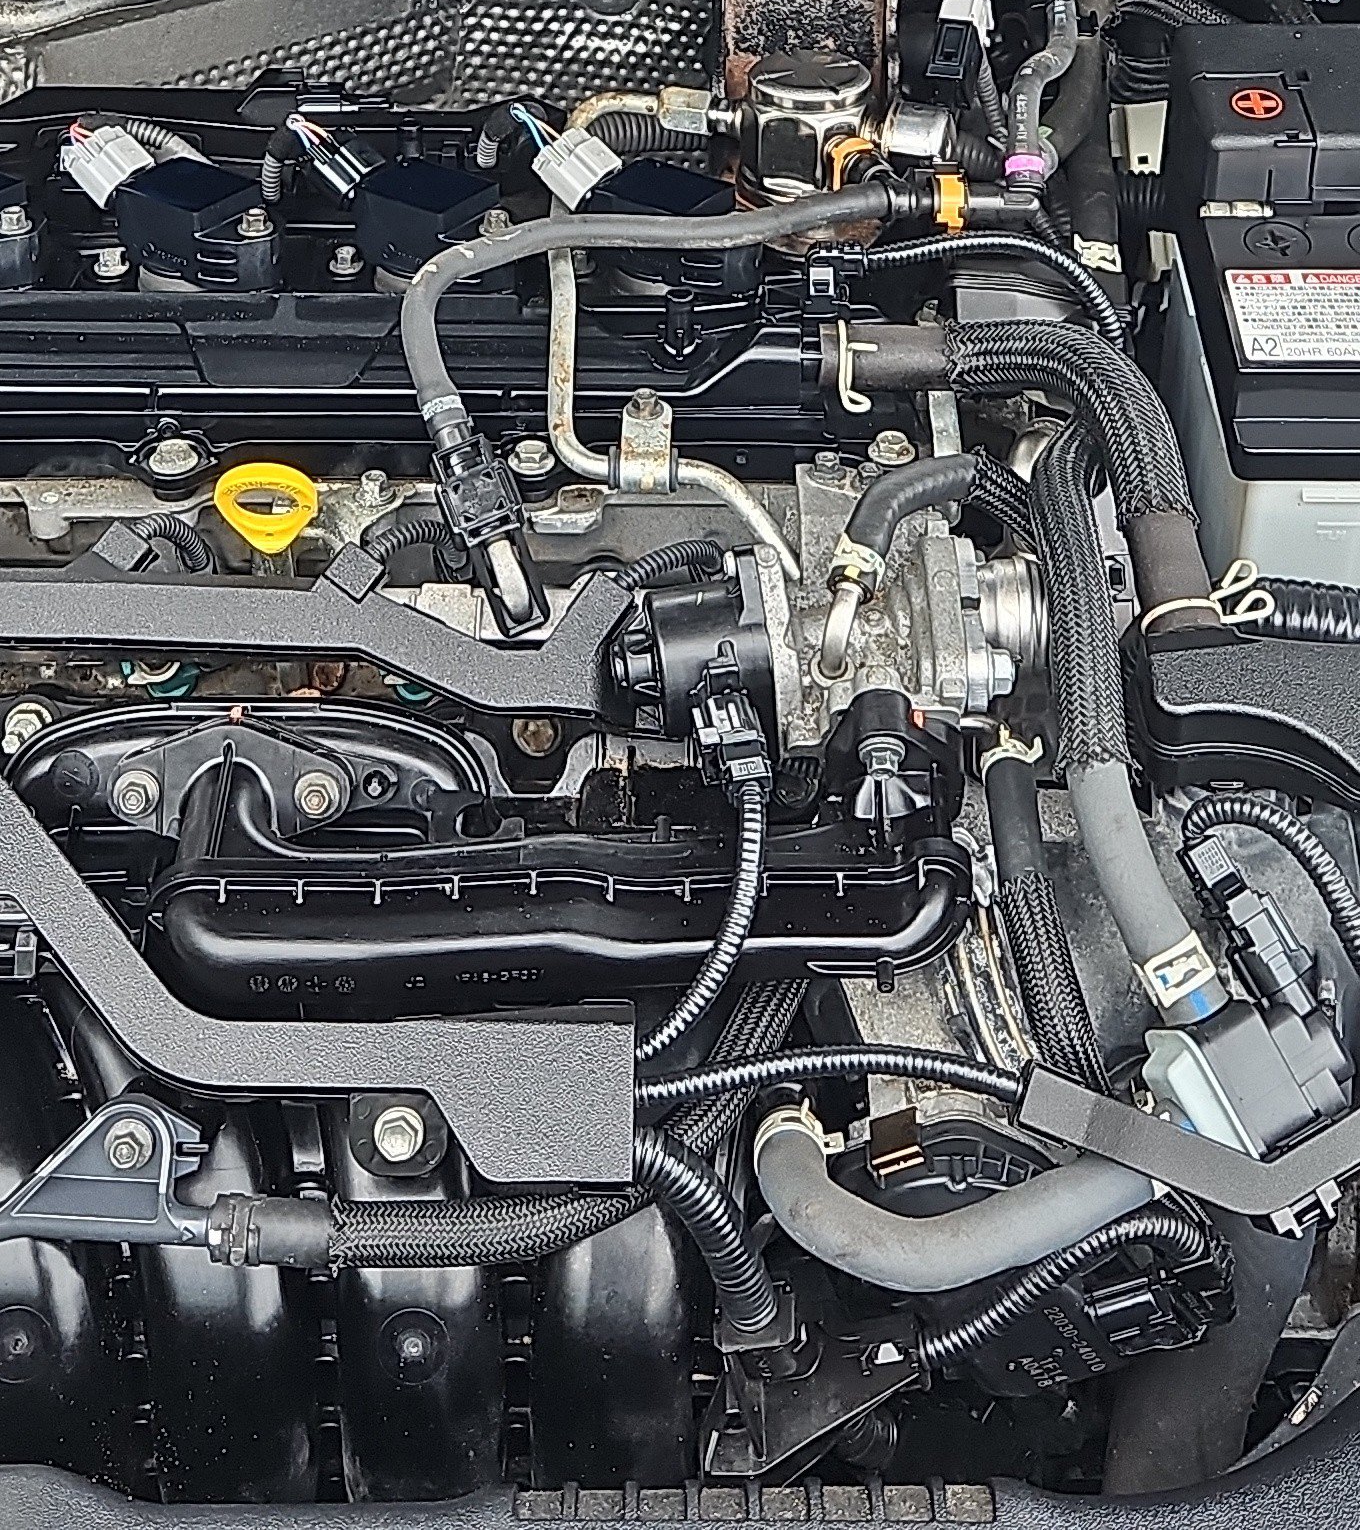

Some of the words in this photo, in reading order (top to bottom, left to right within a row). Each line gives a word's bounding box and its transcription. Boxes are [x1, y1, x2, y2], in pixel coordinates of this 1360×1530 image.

[1251, 337, 1281, 357] A2
[1286, 347, 1323, 357] 20HR
[1327, 347, 1360, 357] 60Ah
[1042, 1306, 1107, 1372] 22030-24010
